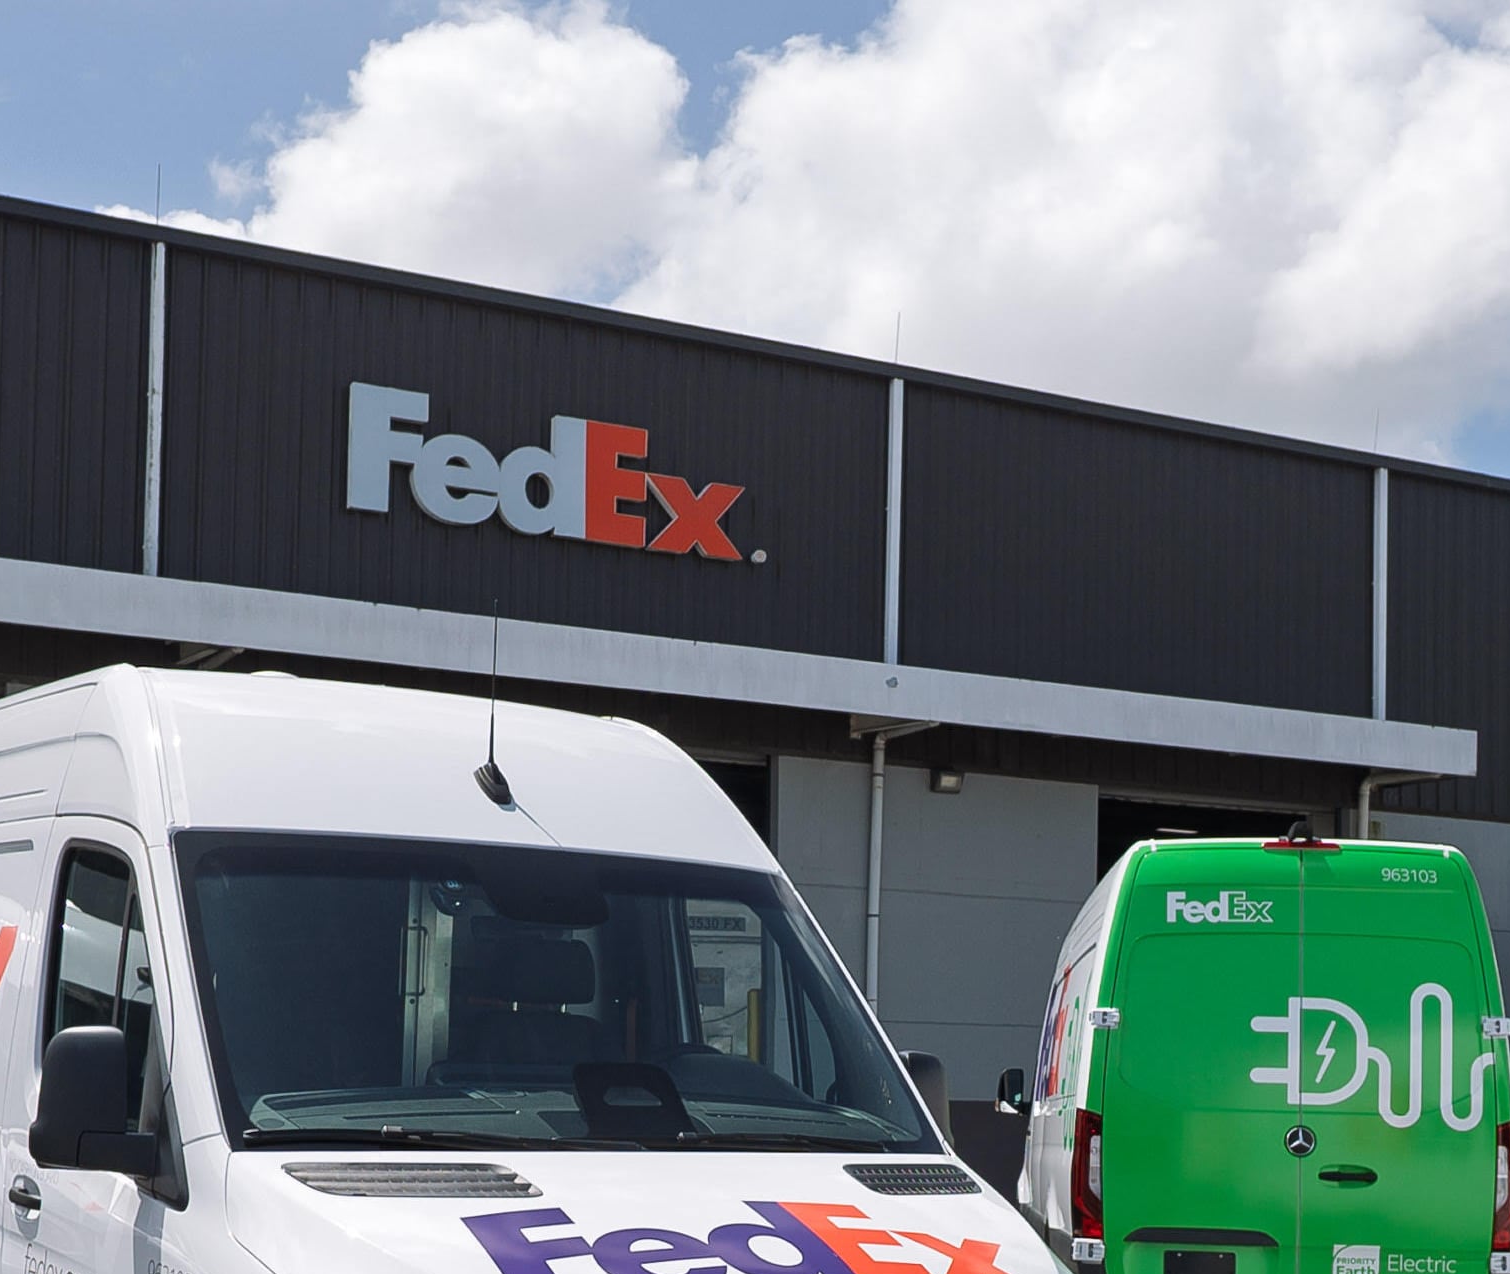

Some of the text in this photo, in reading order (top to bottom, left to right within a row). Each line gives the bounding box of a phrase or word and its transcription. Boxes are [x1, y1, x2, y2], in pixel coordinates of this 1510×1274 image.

[1380, 867, 1438, 884] 963103
[1166, 890, 1274, 923] FedEx
[1336, 1257, 1377, 1265] PRIORITY
[1387, 1253, 1458, 1274] Electric
